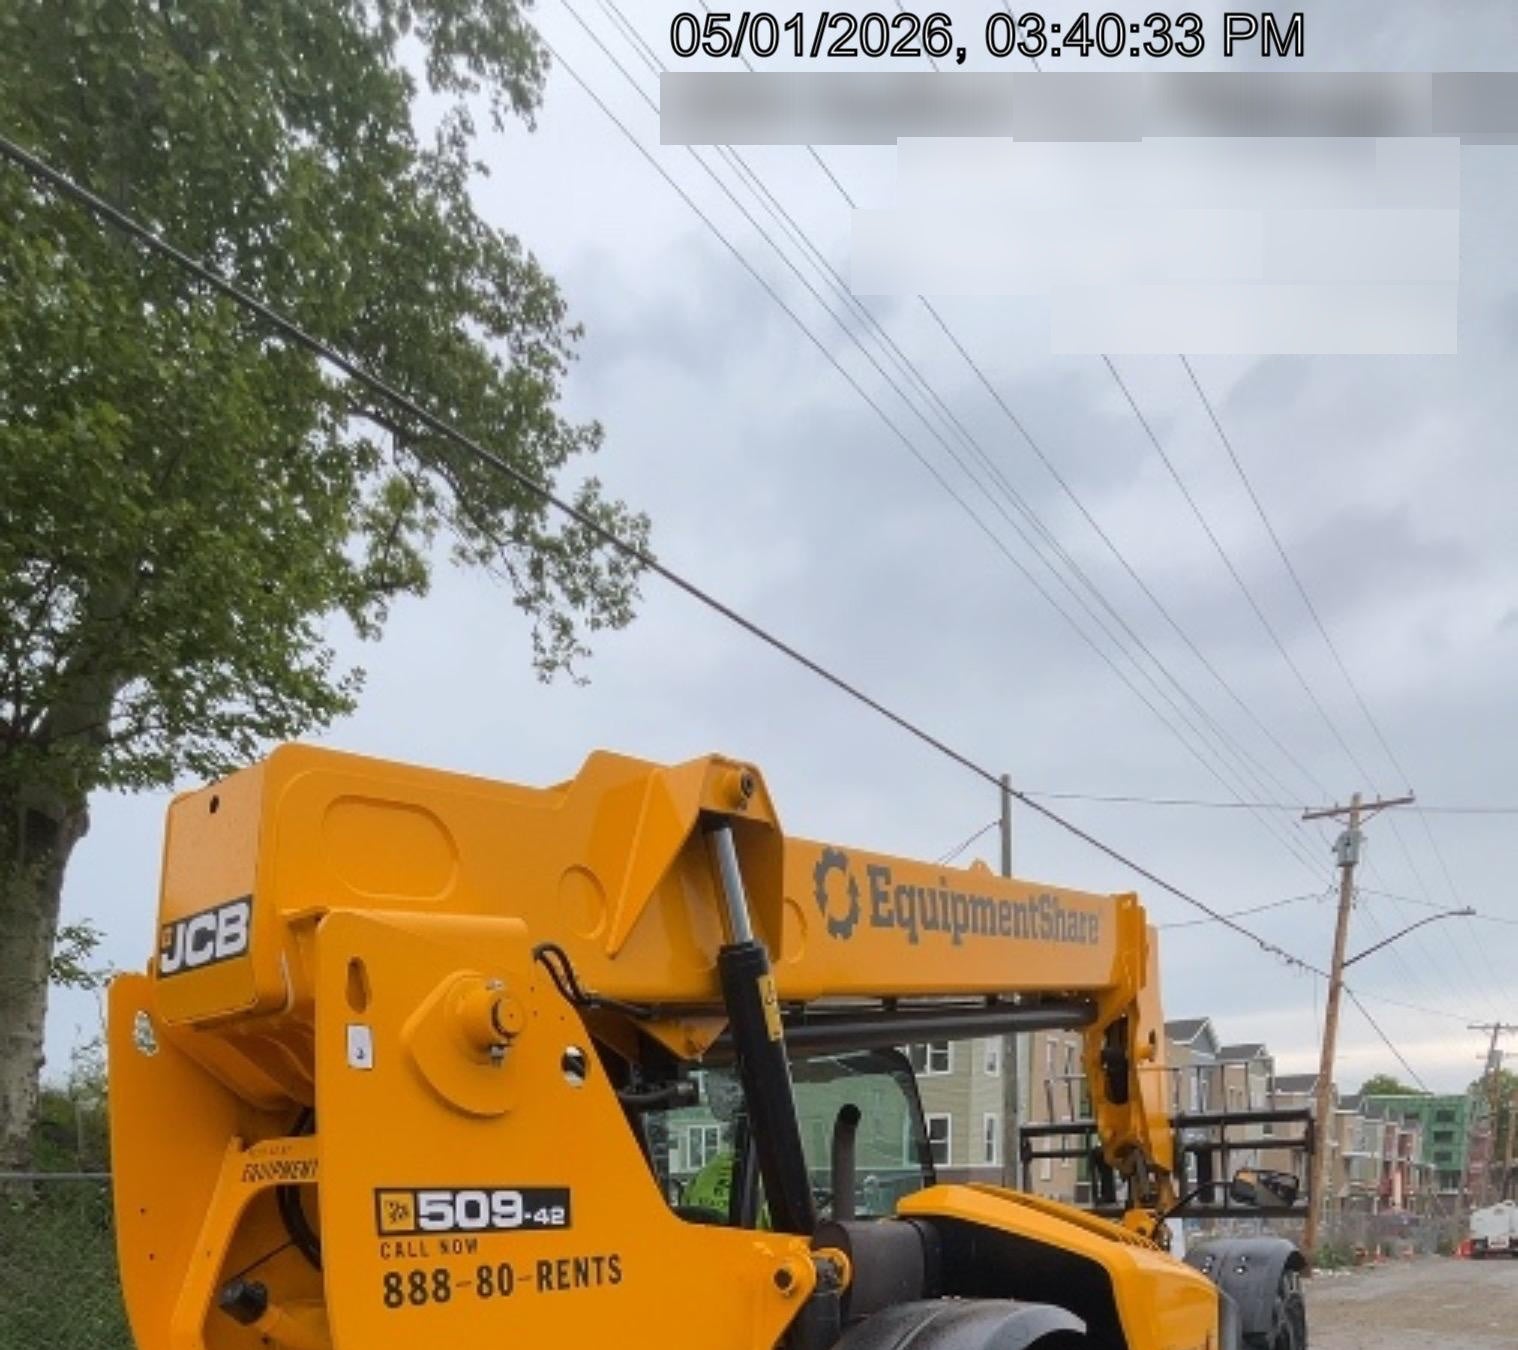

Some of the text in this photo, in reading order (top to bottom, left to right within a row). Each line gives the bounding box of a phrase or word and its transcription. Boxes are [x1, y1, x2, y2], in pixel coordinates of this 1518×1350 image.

[866, 863, 1099, 945] EquipmentShare
[160, 901, 250, 973] JCB
[416, 1190, 566, 1231] 509-42
[380, 1238, 479, 1260] CALL NOW
[383, 1254, 622, 1308] 888-80-RENTS
